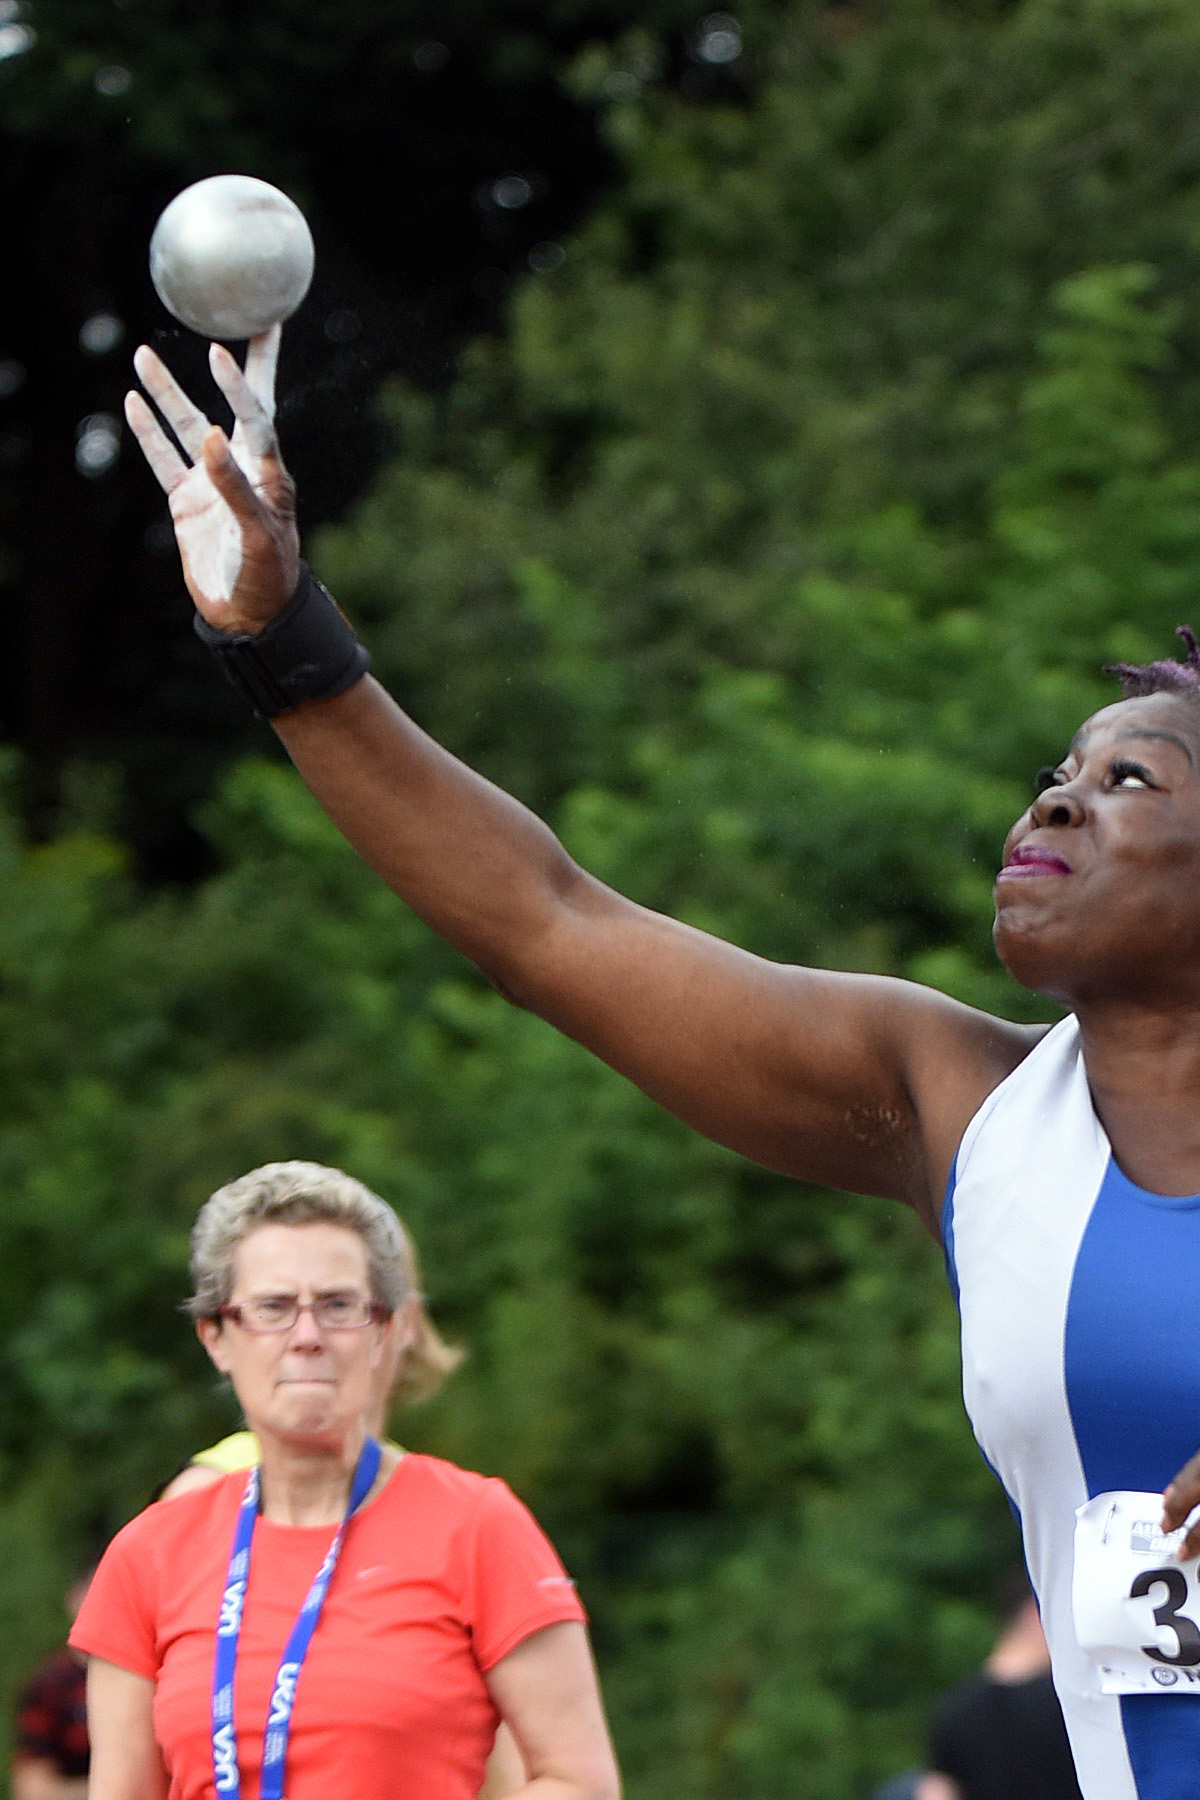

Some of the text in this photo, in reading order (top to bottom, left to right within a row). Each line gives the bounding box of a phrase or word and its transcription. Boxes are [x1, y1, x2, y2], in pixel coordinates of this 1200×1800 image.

[218, 1580, 245, 1637] UKA
[268, 1662, 301, 1726] UKA
[212, 1723, 240, 1793] UKA
